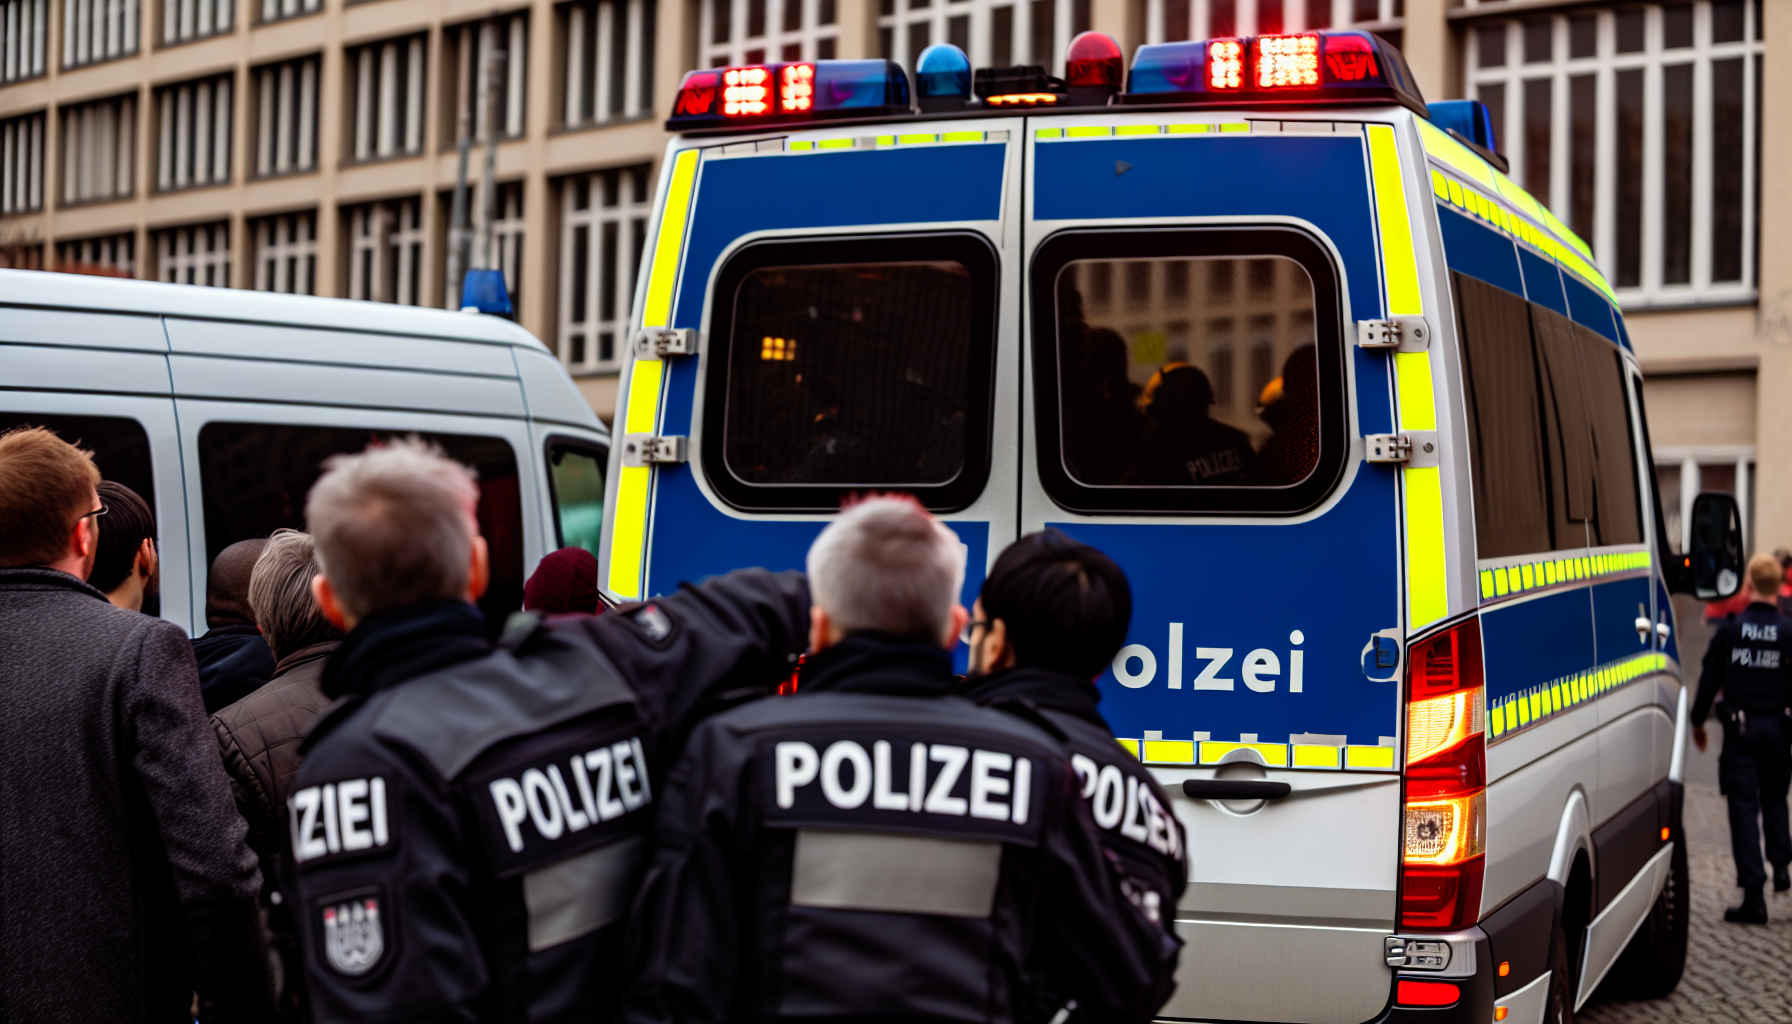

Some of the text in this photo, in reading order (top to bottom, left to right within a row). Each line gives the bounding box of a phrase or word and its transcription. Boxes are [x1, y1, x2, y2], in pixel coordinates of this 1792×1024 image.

[1112, 622, 1304, 693] olzei
[288, 776, 389, 863] ZIEI
[489, 737, 651, 853] POLIZEI
[775, 740, 1032, 825] POLIZEI
